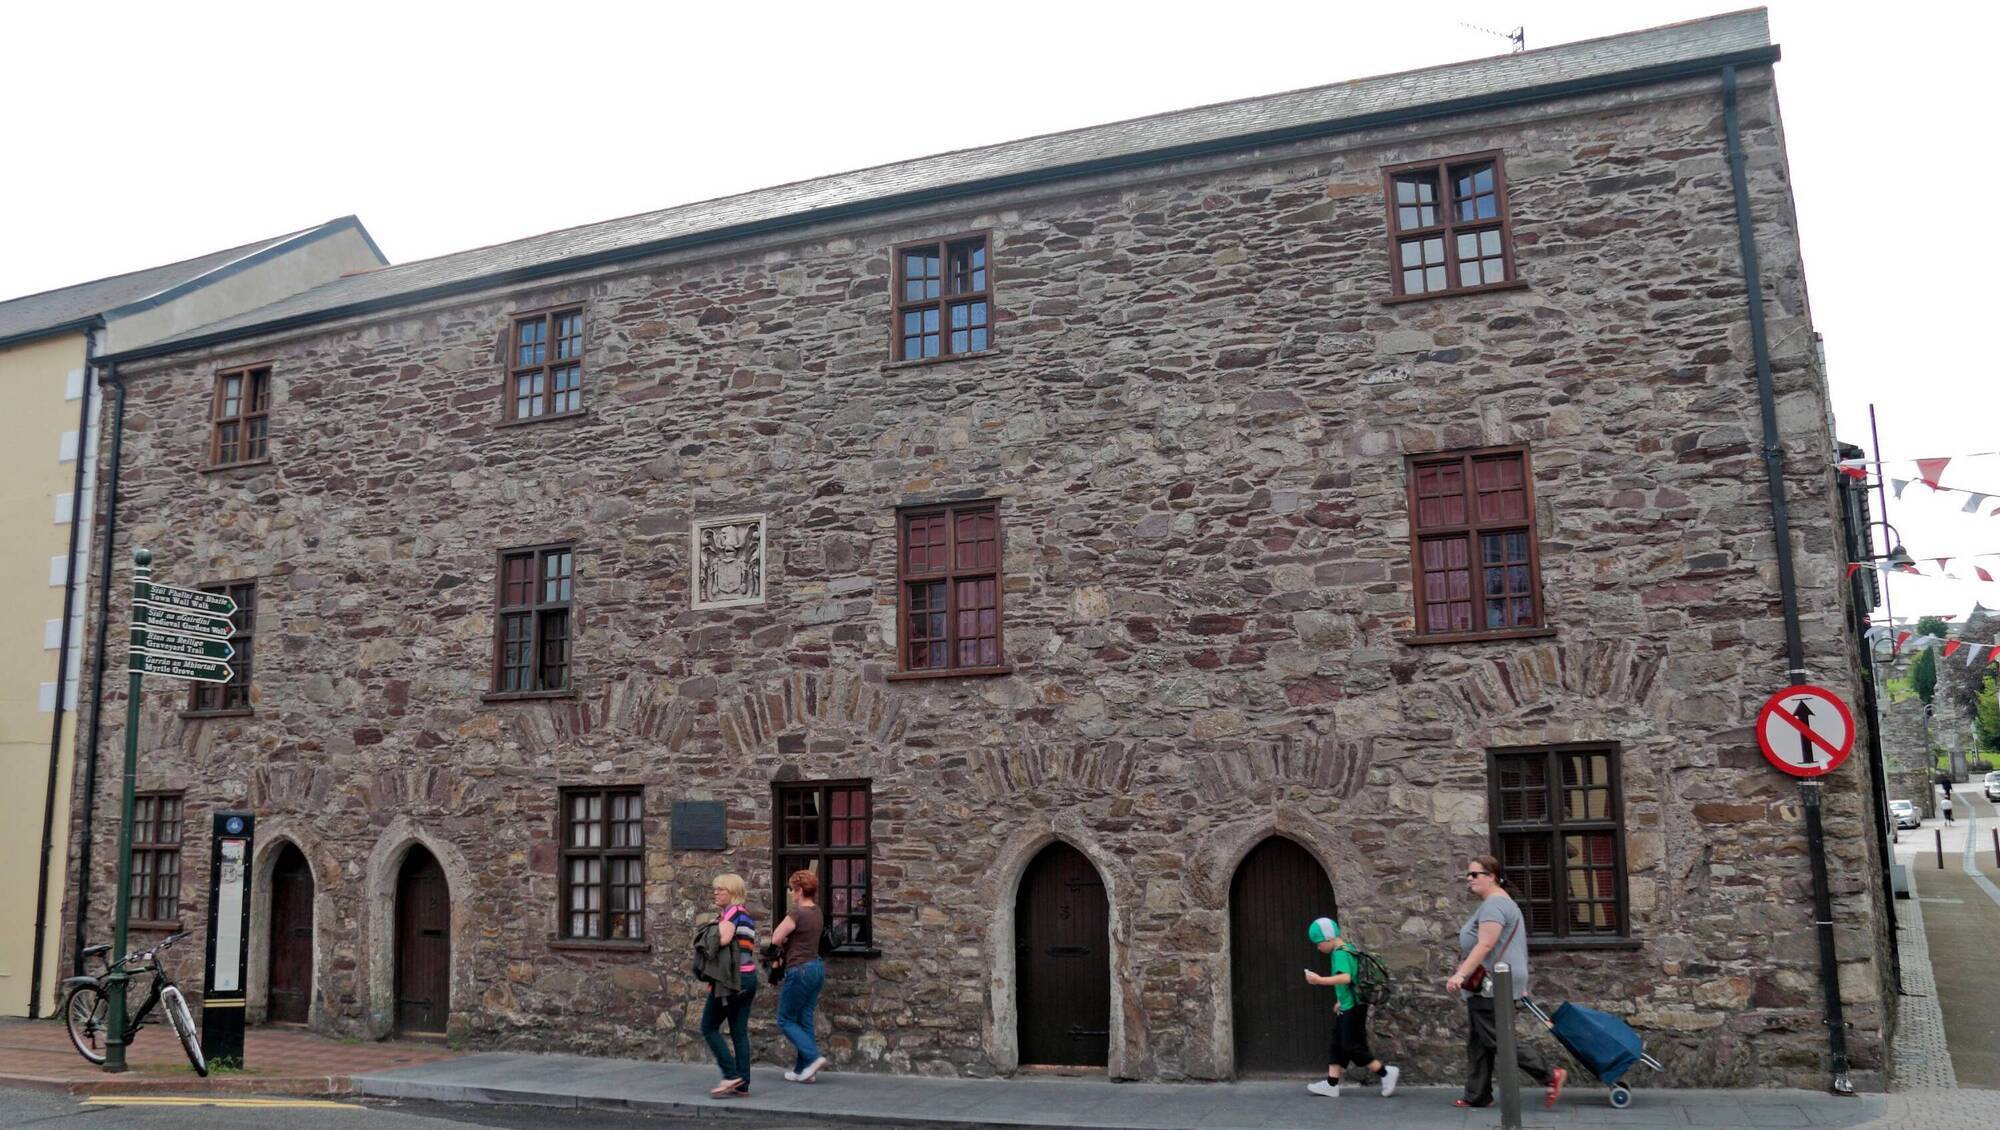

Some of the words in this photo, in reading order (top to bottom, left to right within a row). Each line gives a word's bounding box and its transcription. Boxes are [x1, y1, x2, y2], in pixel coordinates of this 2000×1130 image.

[151, 593, 170, 603] Town
[173, 596, 190, 606] Wall
[191, 600, 209, 609] Walk
[148, 617, 180, 628] Medieval
[182, 622, 210, 633] Gardens
[146, 640, 185, 651] Graveyard
[187, 645, 204, 654] Trail
[145, 663, 170, 673] Myrtle
[172, 666, 195, 676] Grove
[1060, 905, 1071, 920] 3
